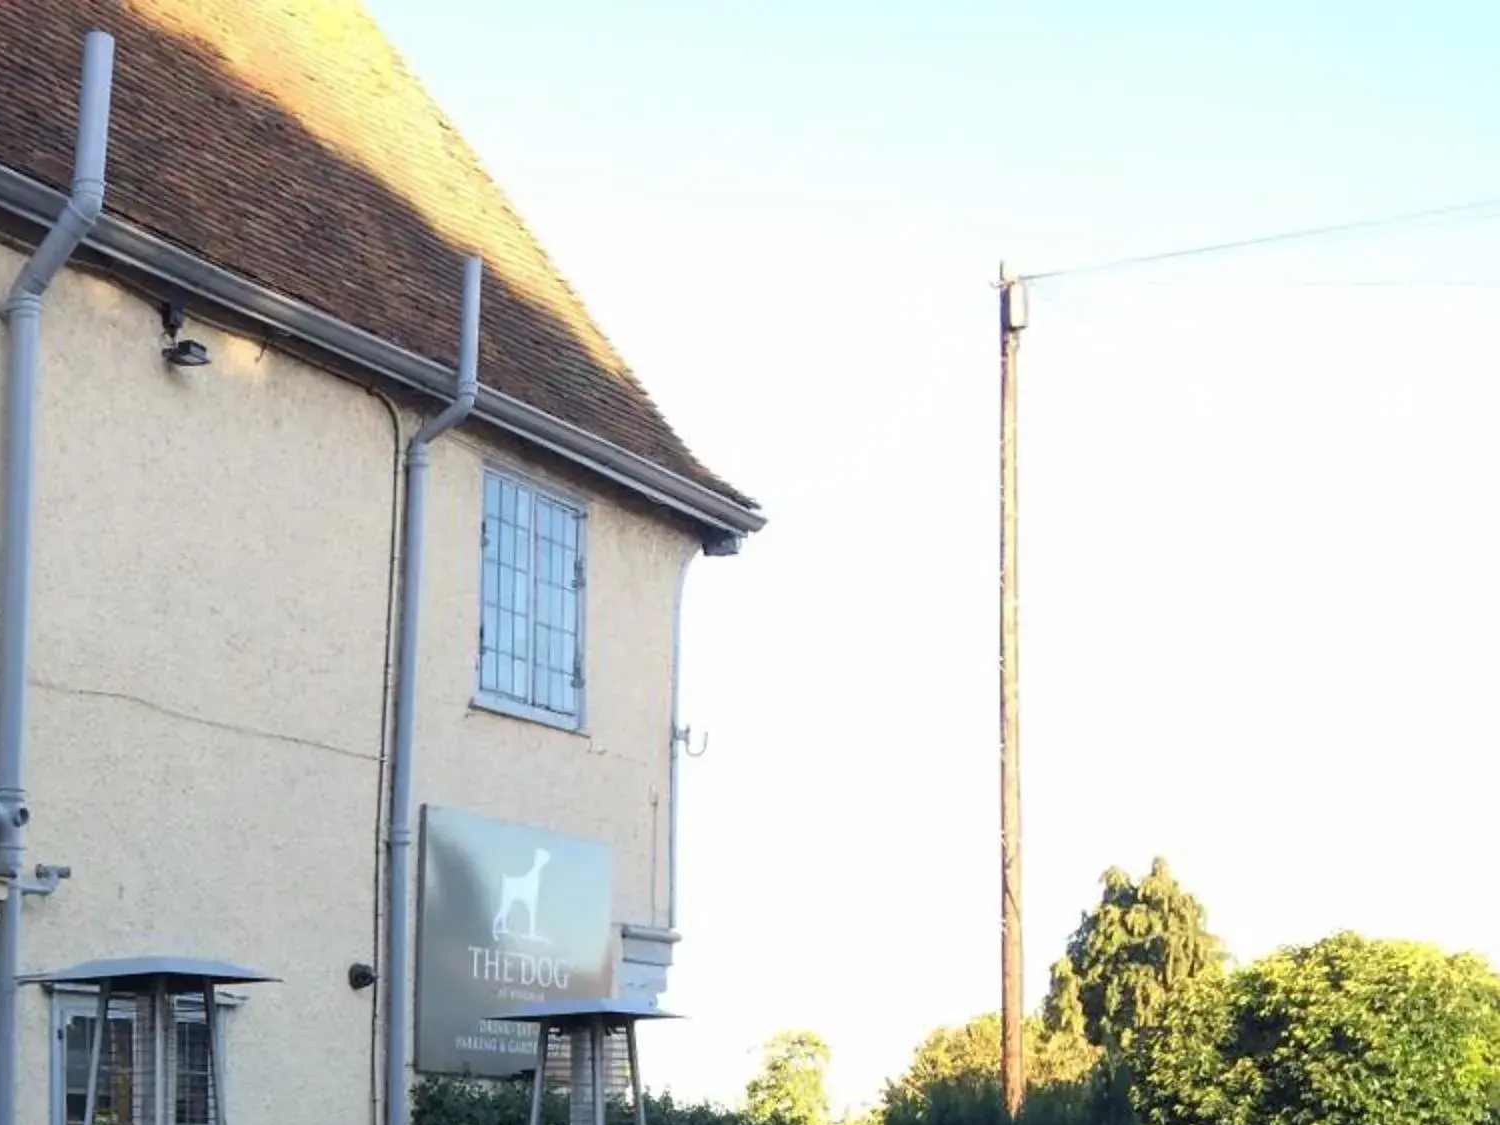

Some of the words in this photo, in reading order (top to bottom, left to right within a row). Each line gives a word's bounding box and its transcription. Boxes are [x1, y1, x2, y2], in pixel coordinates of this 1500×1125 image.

[467, 944, 514, 983] THE
[520, 952, 570, 989] DOG
[455, 1035, 496, 1052] PARKING
